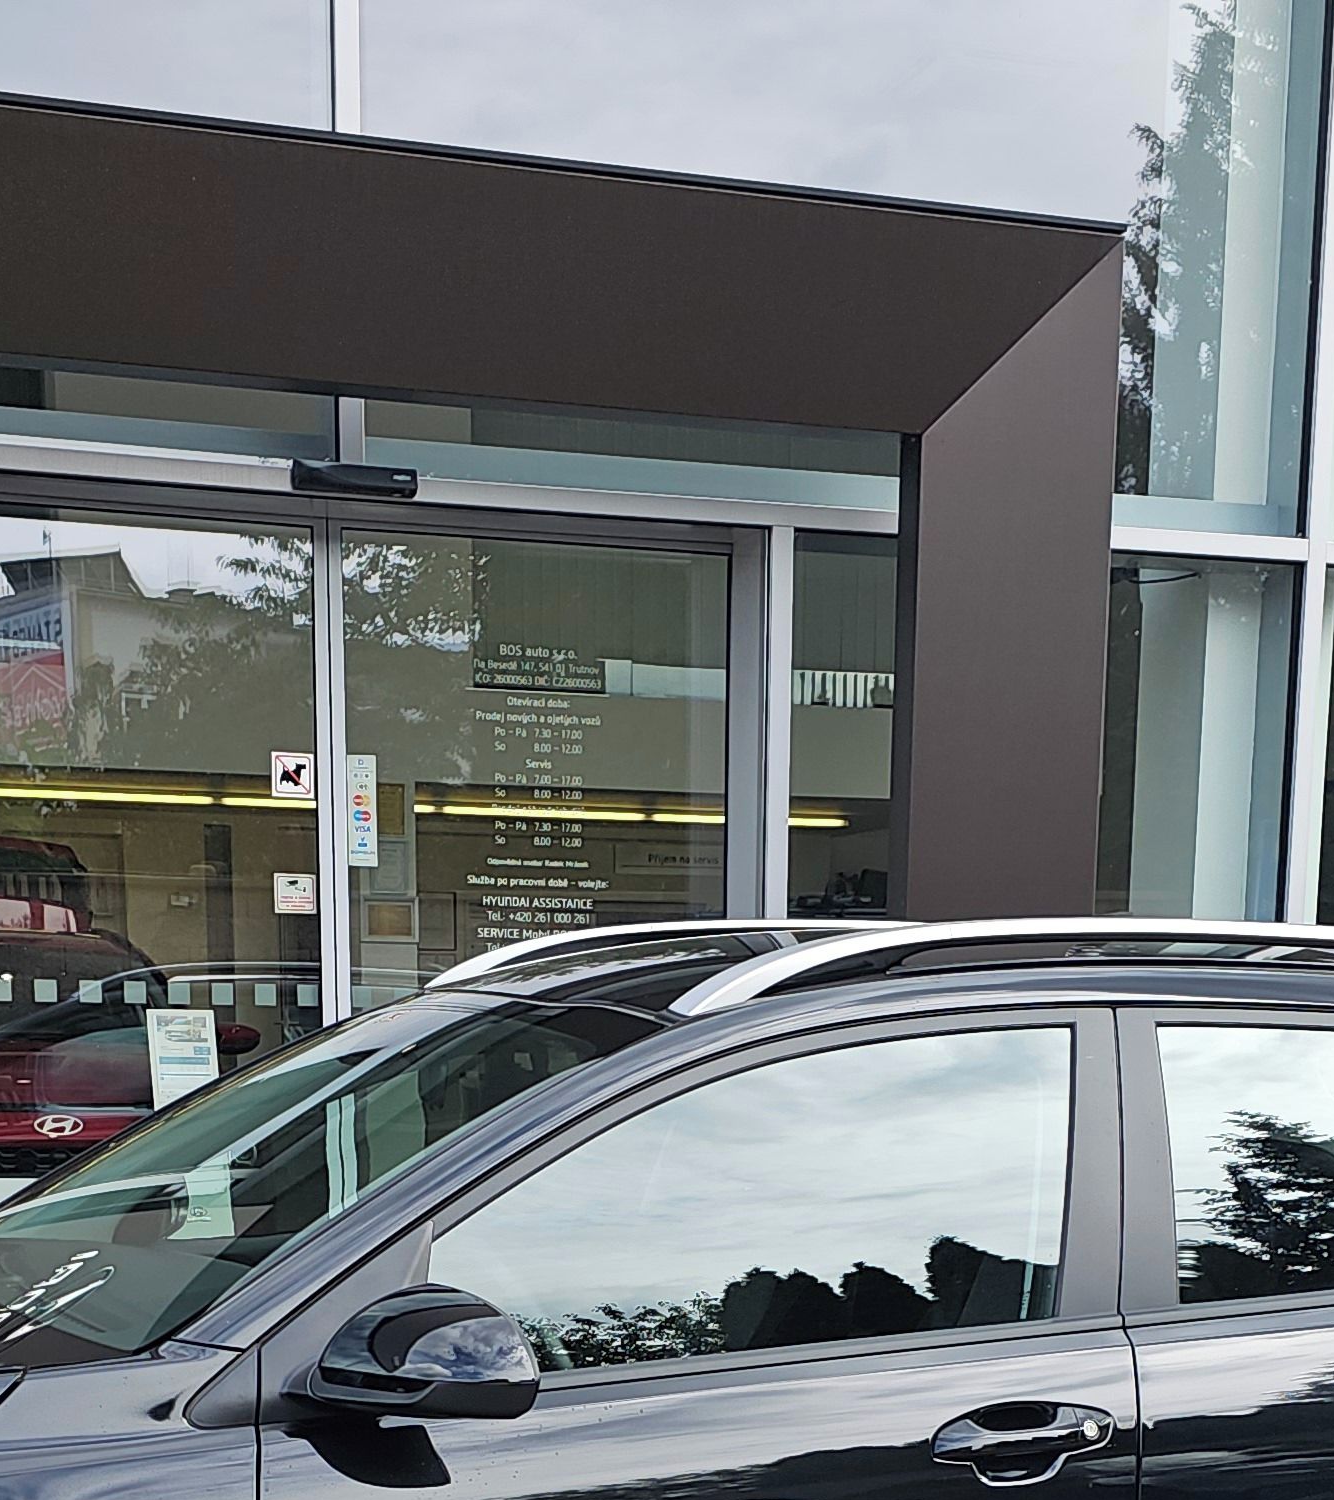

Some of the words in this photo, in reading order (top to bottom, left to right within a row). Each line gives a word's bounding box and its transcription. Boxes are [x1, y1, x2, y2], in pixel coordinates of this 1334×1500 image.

[499, 644, 522, 656] BOS
[525, 647, 549, 658] auto
[552, 649, 578, 660] s.r.o.
[539, 662, 553, 673] 541
[569, 663, 599, 675] Trutnov
[547, 697, 571, 708] doba:
[475, 711, 504, 724] Prodej
[507, 711, 537, 725] nových
[539, 715, 545, 723] a
[547, 714, 578, 726] ojetých
[581, 715, 601, 726] vozů
[494, 727, 506, 737] Po
[515, 727, 527, 738] Pá
[534, 728, 552, 739] 7.30
[561, 730, 583, 740] 17.00
[494, 741, 506, 751] So
[534, 742, 552, 753] 8.00
[561, 744, 583, 754] 12.00
[525, 759, 552, 770] Servis
[494, 773, 506, 783] Po
[515, 773, 527, 784] Pá
[534, 774, 552, 785] 7.00
[561, 776, 583, 786] 17.00
[494, 787, 506, 797] So
[534, 788, 552, 799] 8.00
[561, 790, 583, 800] 12.00
[355, 825, 371, 833] VISA
[494, 820, 506, 830] Po
[515, 820, 527, 831] Pá
[534, 821, 552, 832] 7.30
[561, 822, 583, 833] 17.00
[494, 835, 506, 845] So
[534, 836, 552, 847] 8.00
[561, 838, 583, 848] 12.00
[467, 874, 495, 885] Služba
[497, 877, 508, 887] po
[510, 877, 546, 888] pracovní
[548, 878, 568, 888] době
[578, 879, 610, 890] volejte:
[482, 895, 530, 907] HYUNDAI
[532, 897, 594, 910] ASSISTANCE
[508, 911, 532, 923] +420
[534, 912, 551, 923] 261
[553, 912, 572, 924] 000
[573, 913, 590, 924] 261
[477, 927, 520, 939] SERVICE
